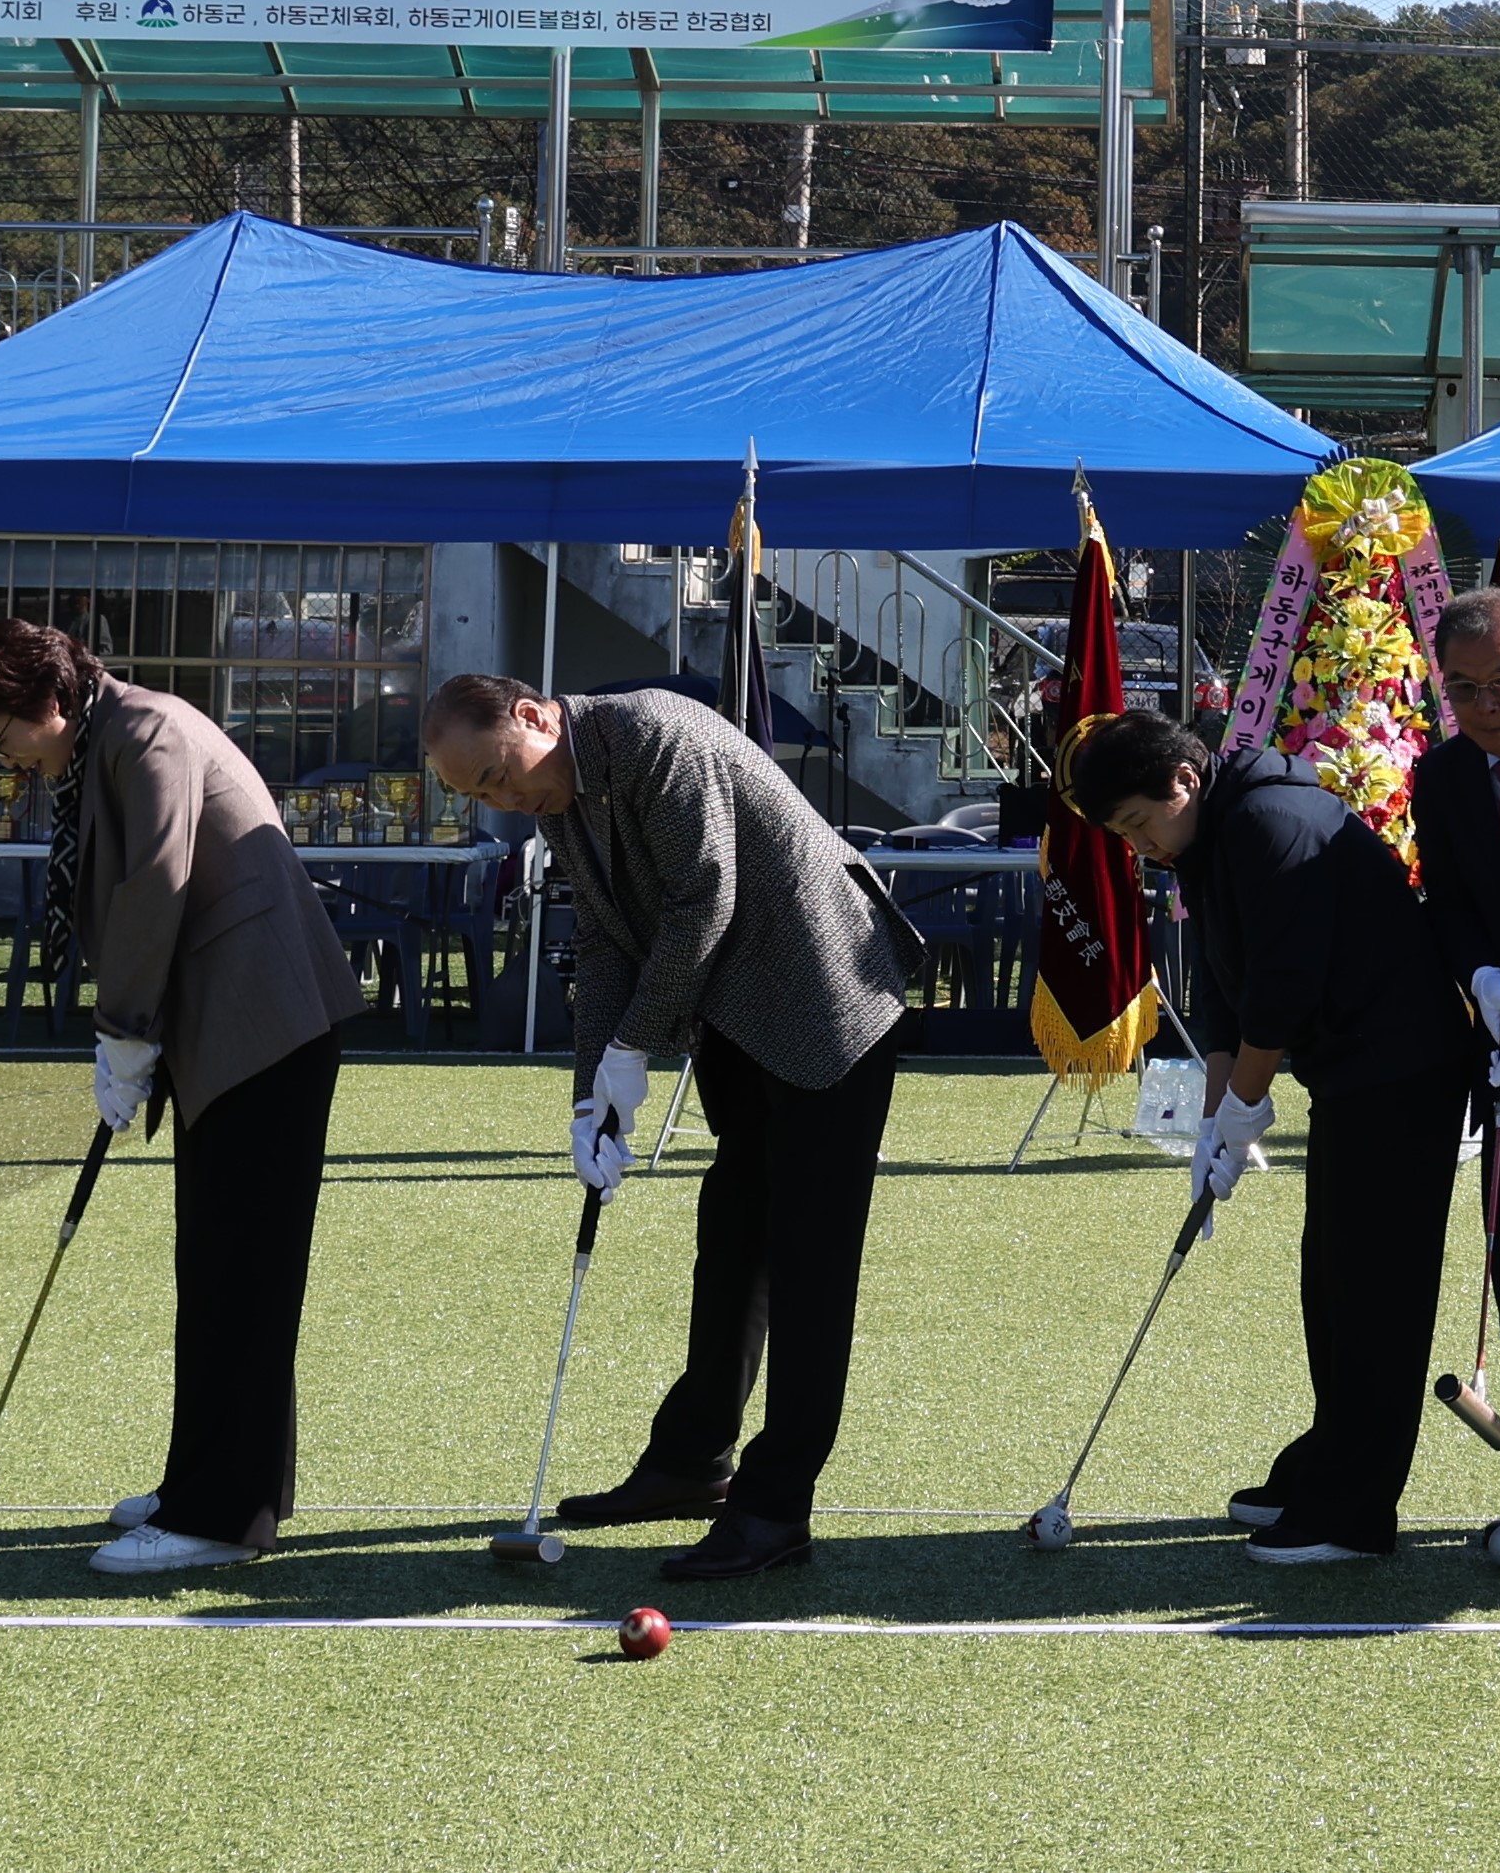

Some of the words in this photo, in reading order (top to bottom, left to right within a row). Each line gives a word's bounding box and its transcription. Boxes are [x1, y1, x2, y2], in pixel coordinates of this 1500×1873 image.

[75, 1, 118, 23] 후원
[182, 3, 246, 25] 하동군
[265, 4, 400, 29] 하동군체육회,
[408, 7, 608, 33] 하동군게이트볼협회,
[616, 10, 679, 32] 하동군
[686, 11, 771, 33] 한궁협회
[1045, 863, 1104, 967] 郡支會長
